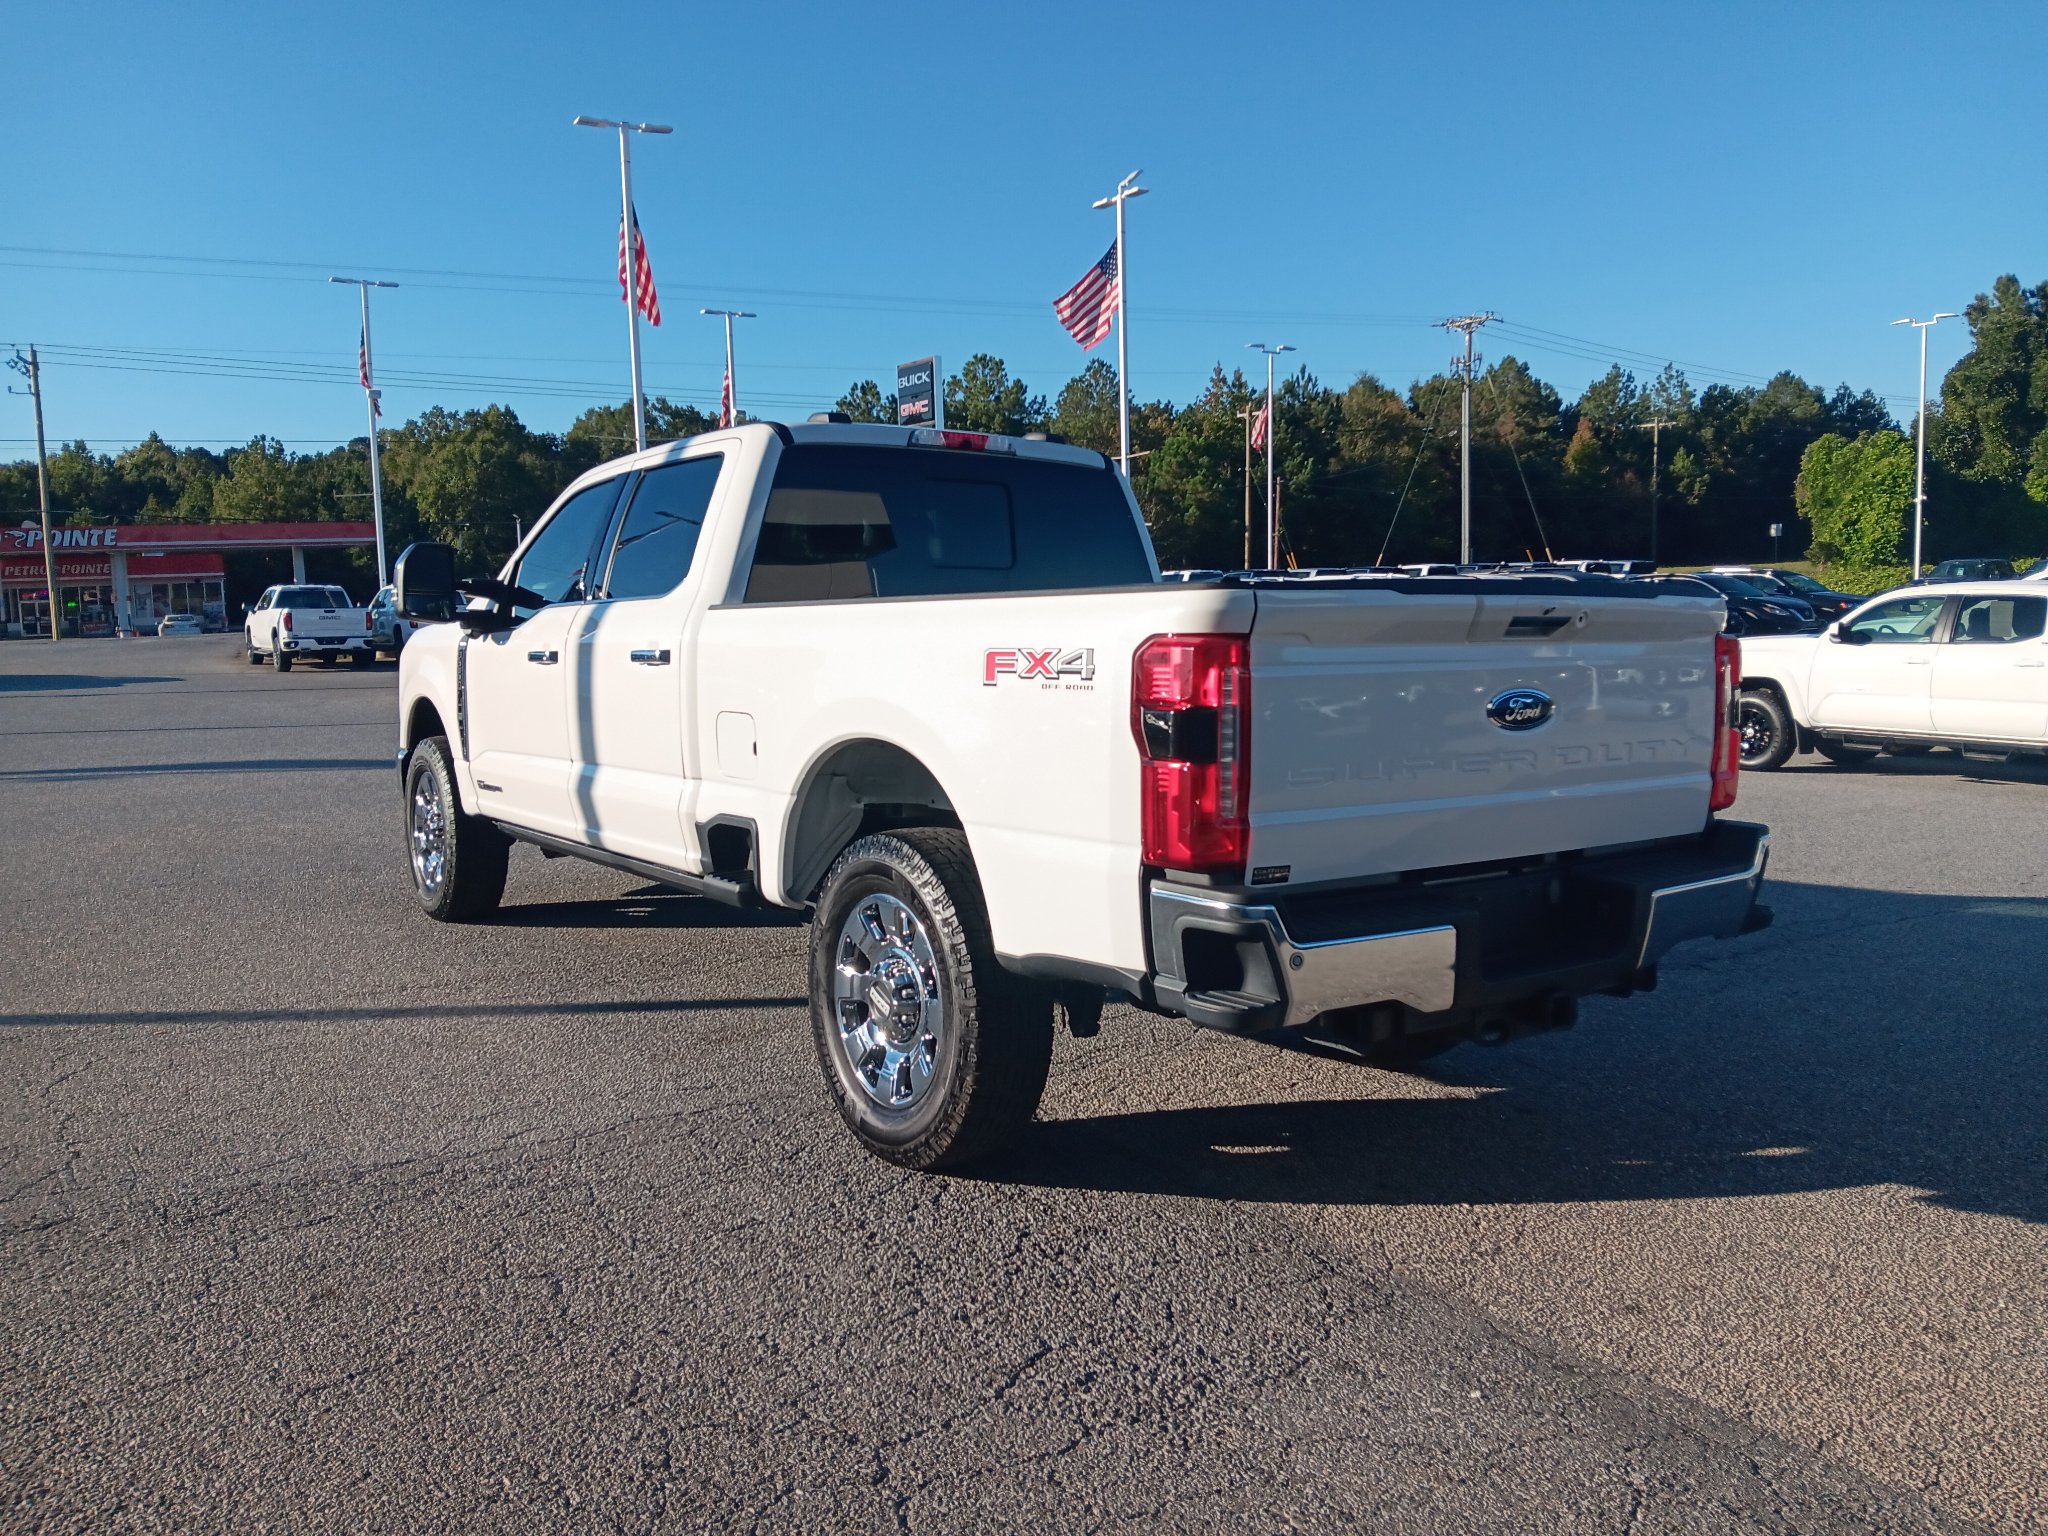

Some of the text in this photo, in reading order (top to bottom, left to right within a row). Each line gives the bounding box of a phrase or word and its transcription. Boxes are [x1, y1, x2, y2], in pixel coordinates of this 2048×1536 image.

[898, 370, 930, 389] BUICK
[900, 399, 929, 417] GMC
[61, 563, 112, 575] POINTE
[983, 648, 1095, 687] FX4
[1041, 683, 1094, 692] OFF ROAD
[1505, 697, 1543, 721] Ford
[1287, 736, 1698, 790] SUPER DUTY
